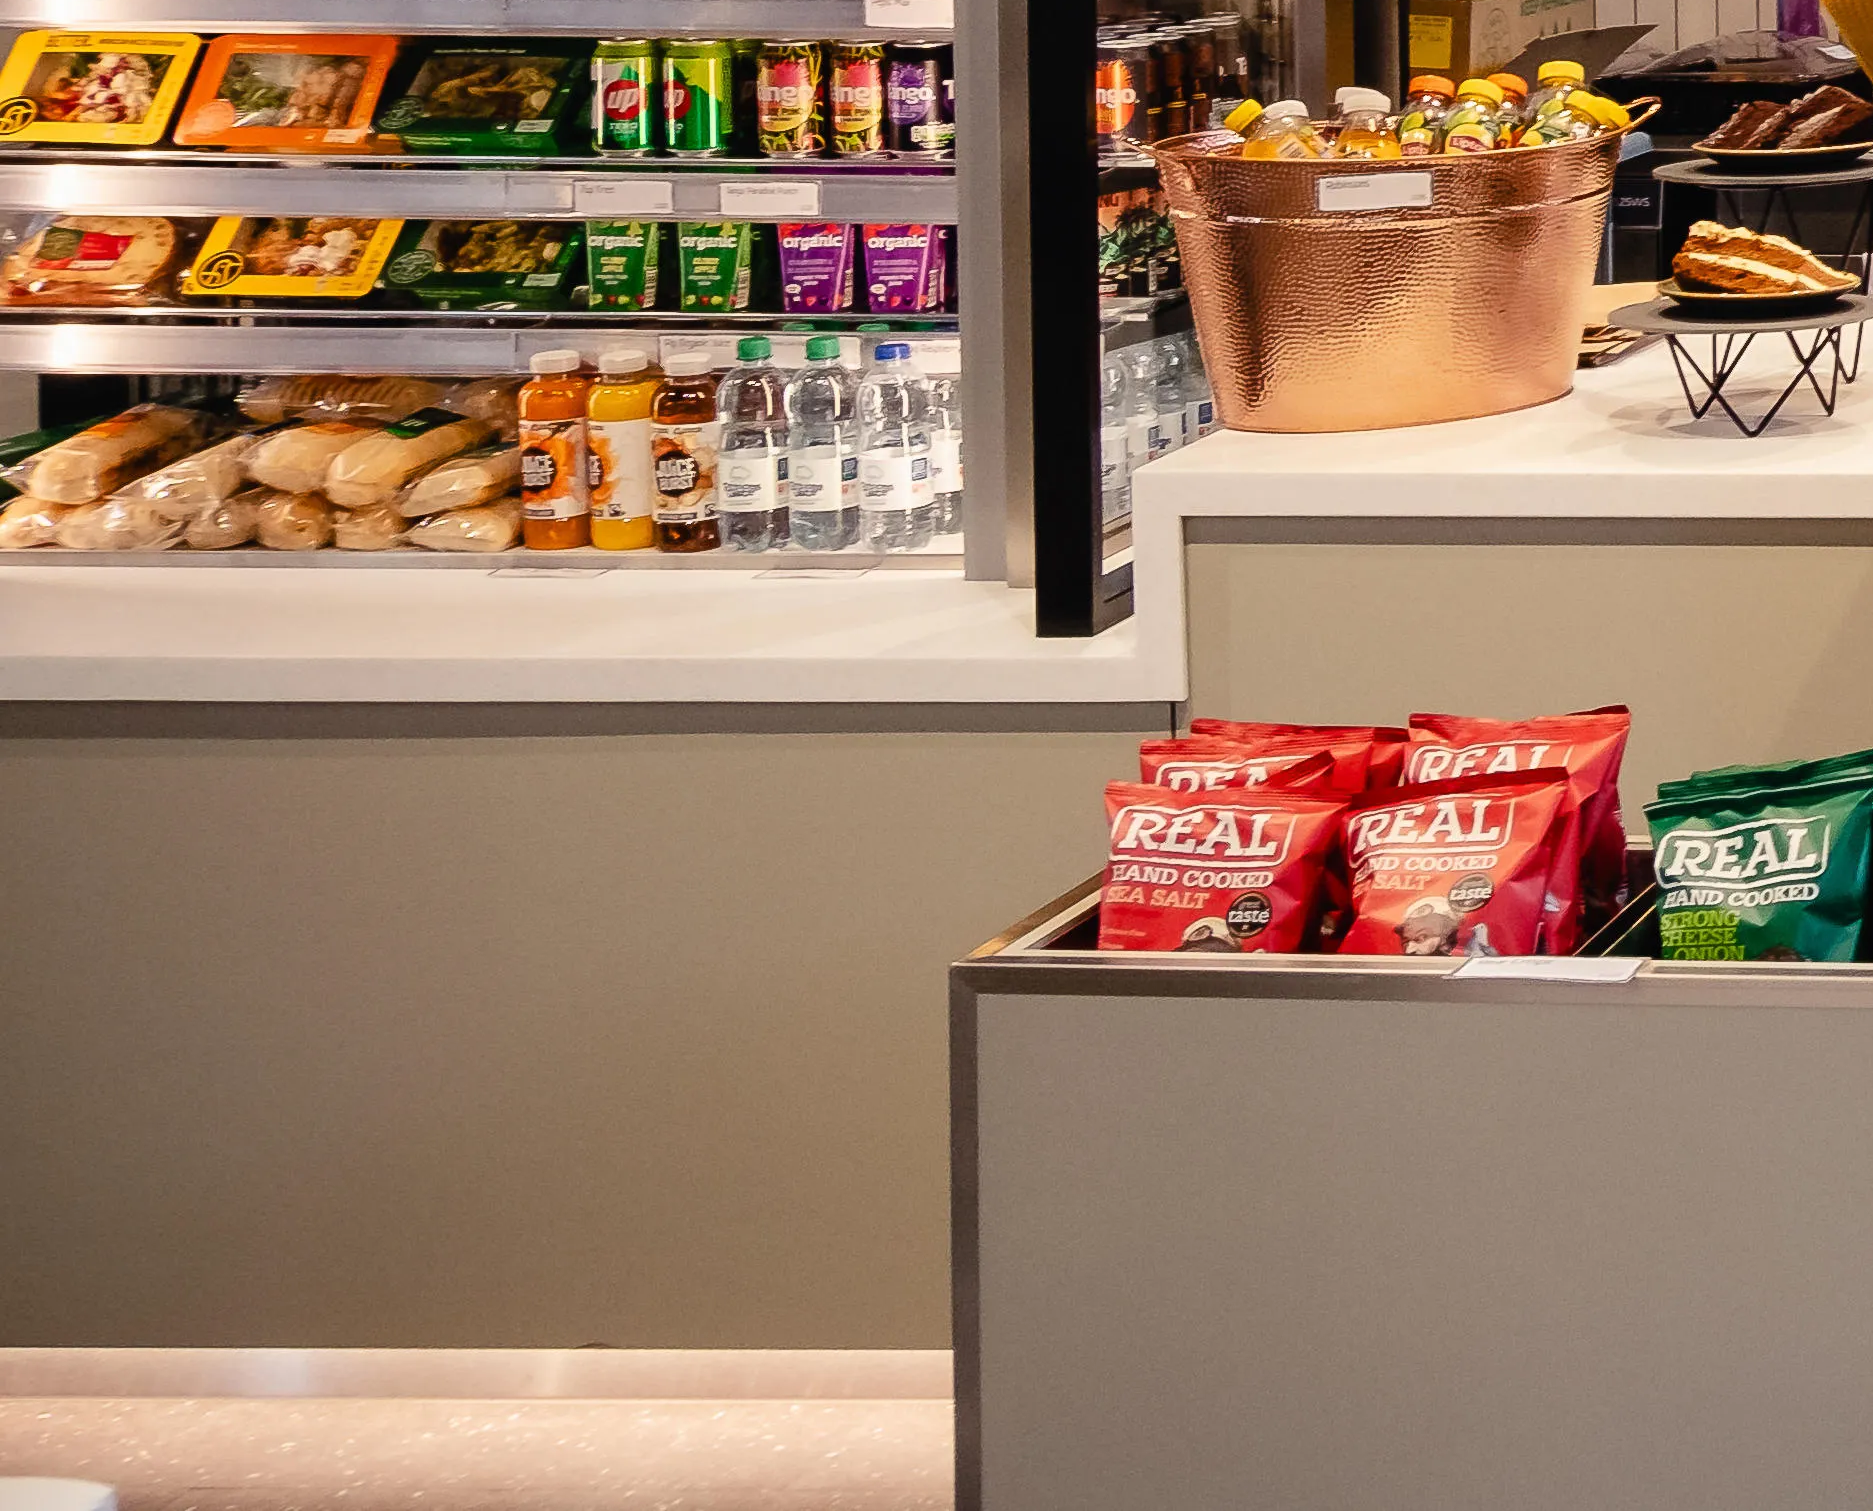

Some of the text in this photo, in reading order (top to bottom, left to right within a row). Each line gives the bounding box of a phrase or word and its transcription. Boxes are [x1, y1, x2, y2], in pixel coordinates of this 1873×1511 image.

[589, 235, 645, 249] organic
[681, 235, 737, 249] organic
[782, 235, 843, 250] organic
[867, 235, 928, 250] organic
[1117, 810, 1279, 857] REAL
[1353, 799, 1502, 855] REAL
[1405, 854, 1498, 872] COOKED
[1665, 828, 1818, 880] REAL
[1111, 864, 1275, 889] HAND COOKED
[1371, 873, 1432, 891] SALT
[1105, 885, 1210, 910] SEA SALT
[1663, 882, 1820, 910] HAND COOKED
[1661, 909, 1741, 931] STRONG
